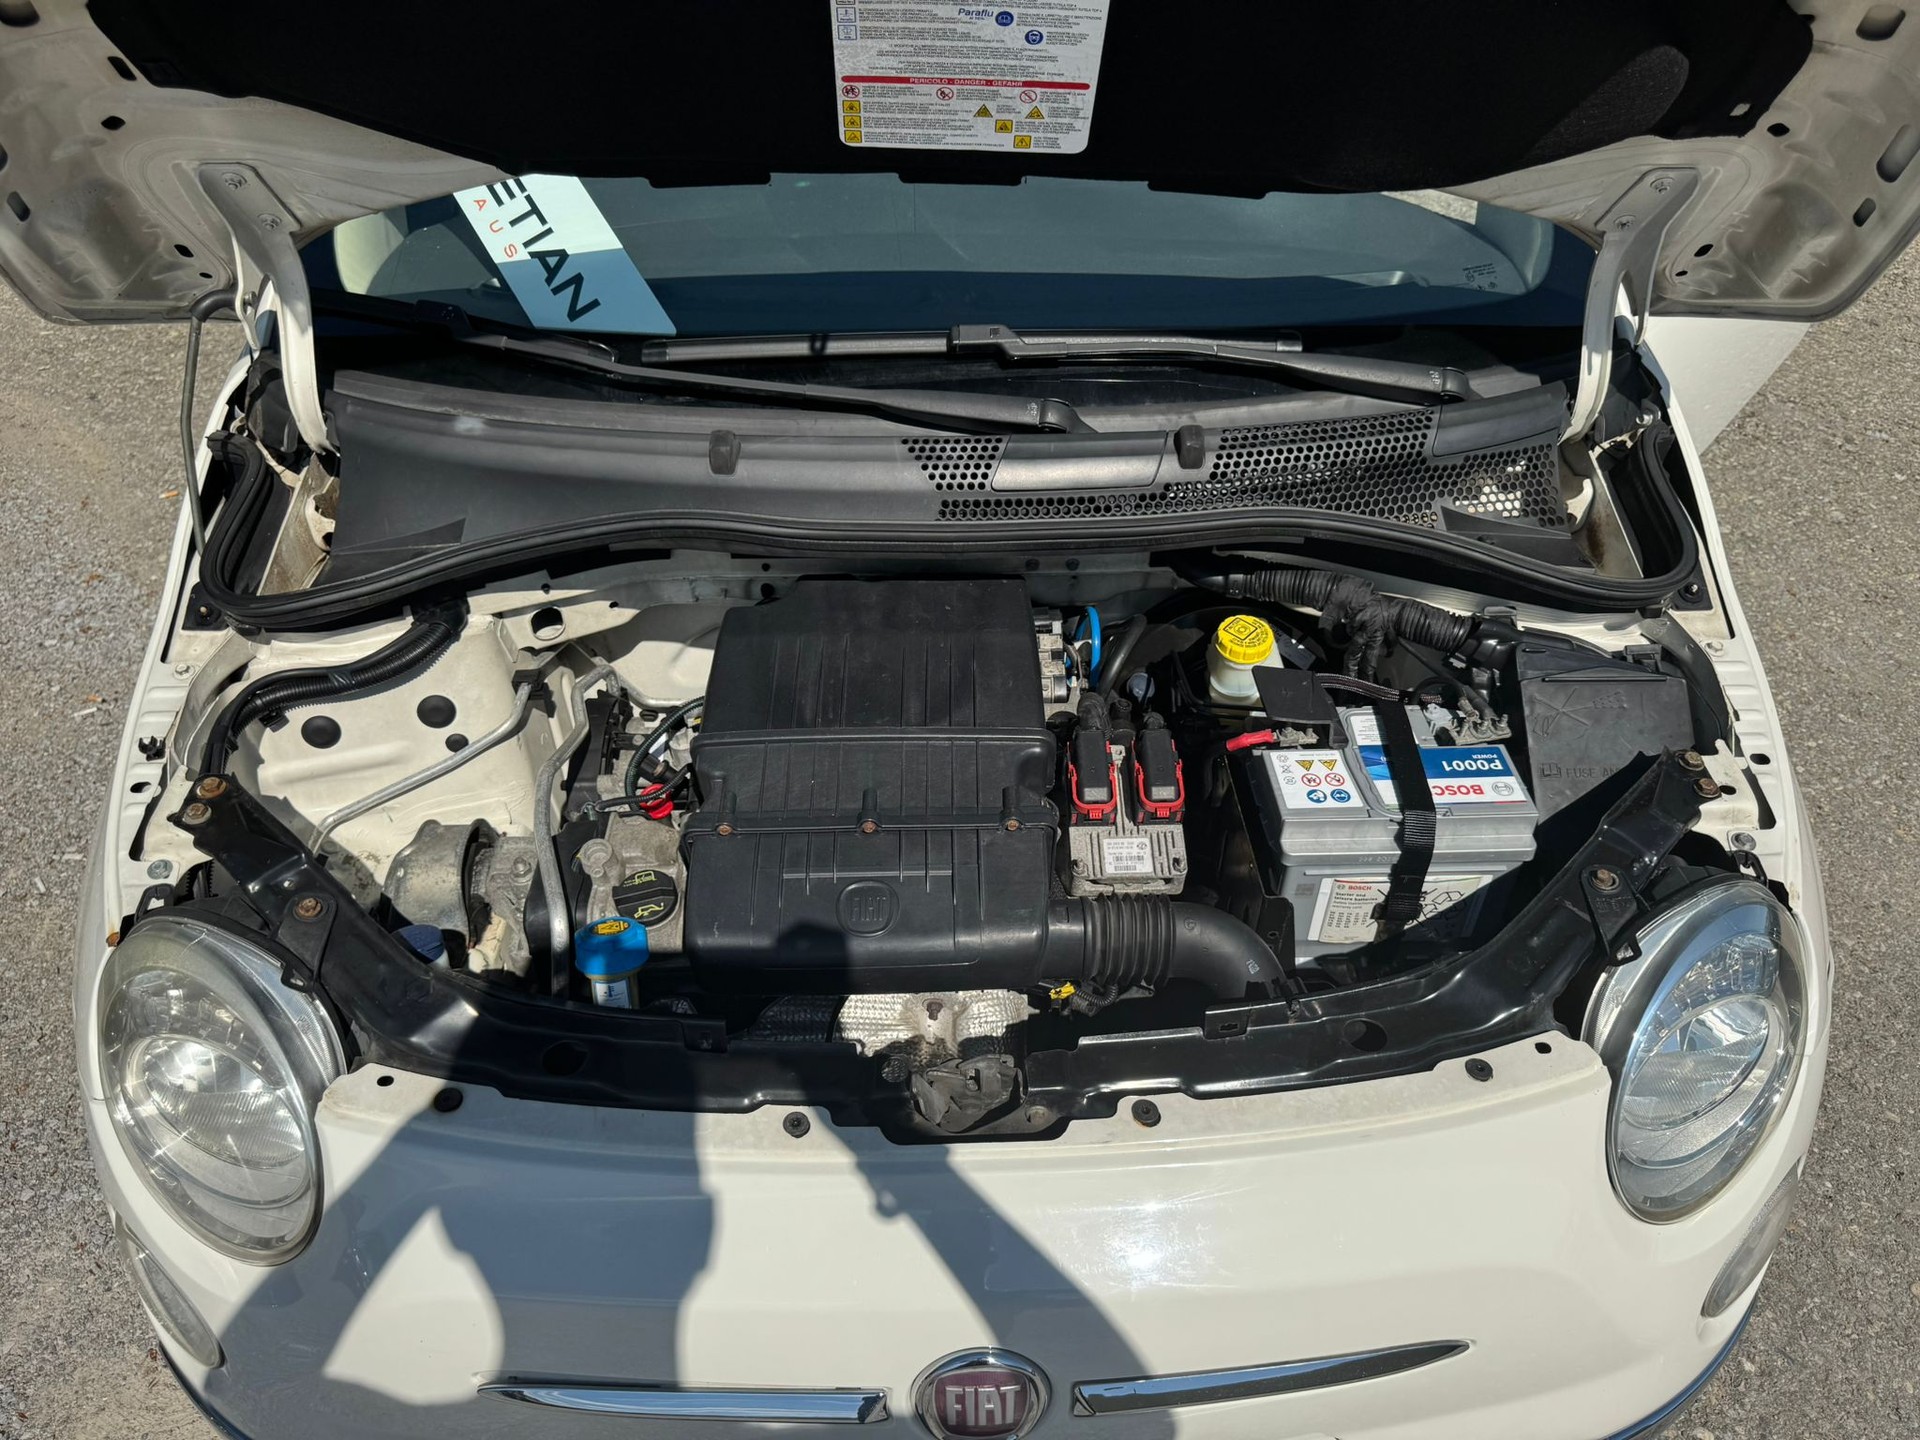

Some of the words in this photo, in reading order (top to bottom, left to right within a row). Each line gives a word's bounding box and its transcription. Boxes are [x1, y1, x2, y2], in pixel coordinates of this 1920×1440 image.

[958, 7, 994, 17] Paraflu
[909, 77, 949, 85] PERICOLO
[1441, 759, 1504, 771] P0001
[1566, 767, 1596, 779] FUSE
[1431, 784, 1485, 796] BOSC
[849, 897, 887, 921] FIAT
[945, 1384, 1021, 1426] FIAT
